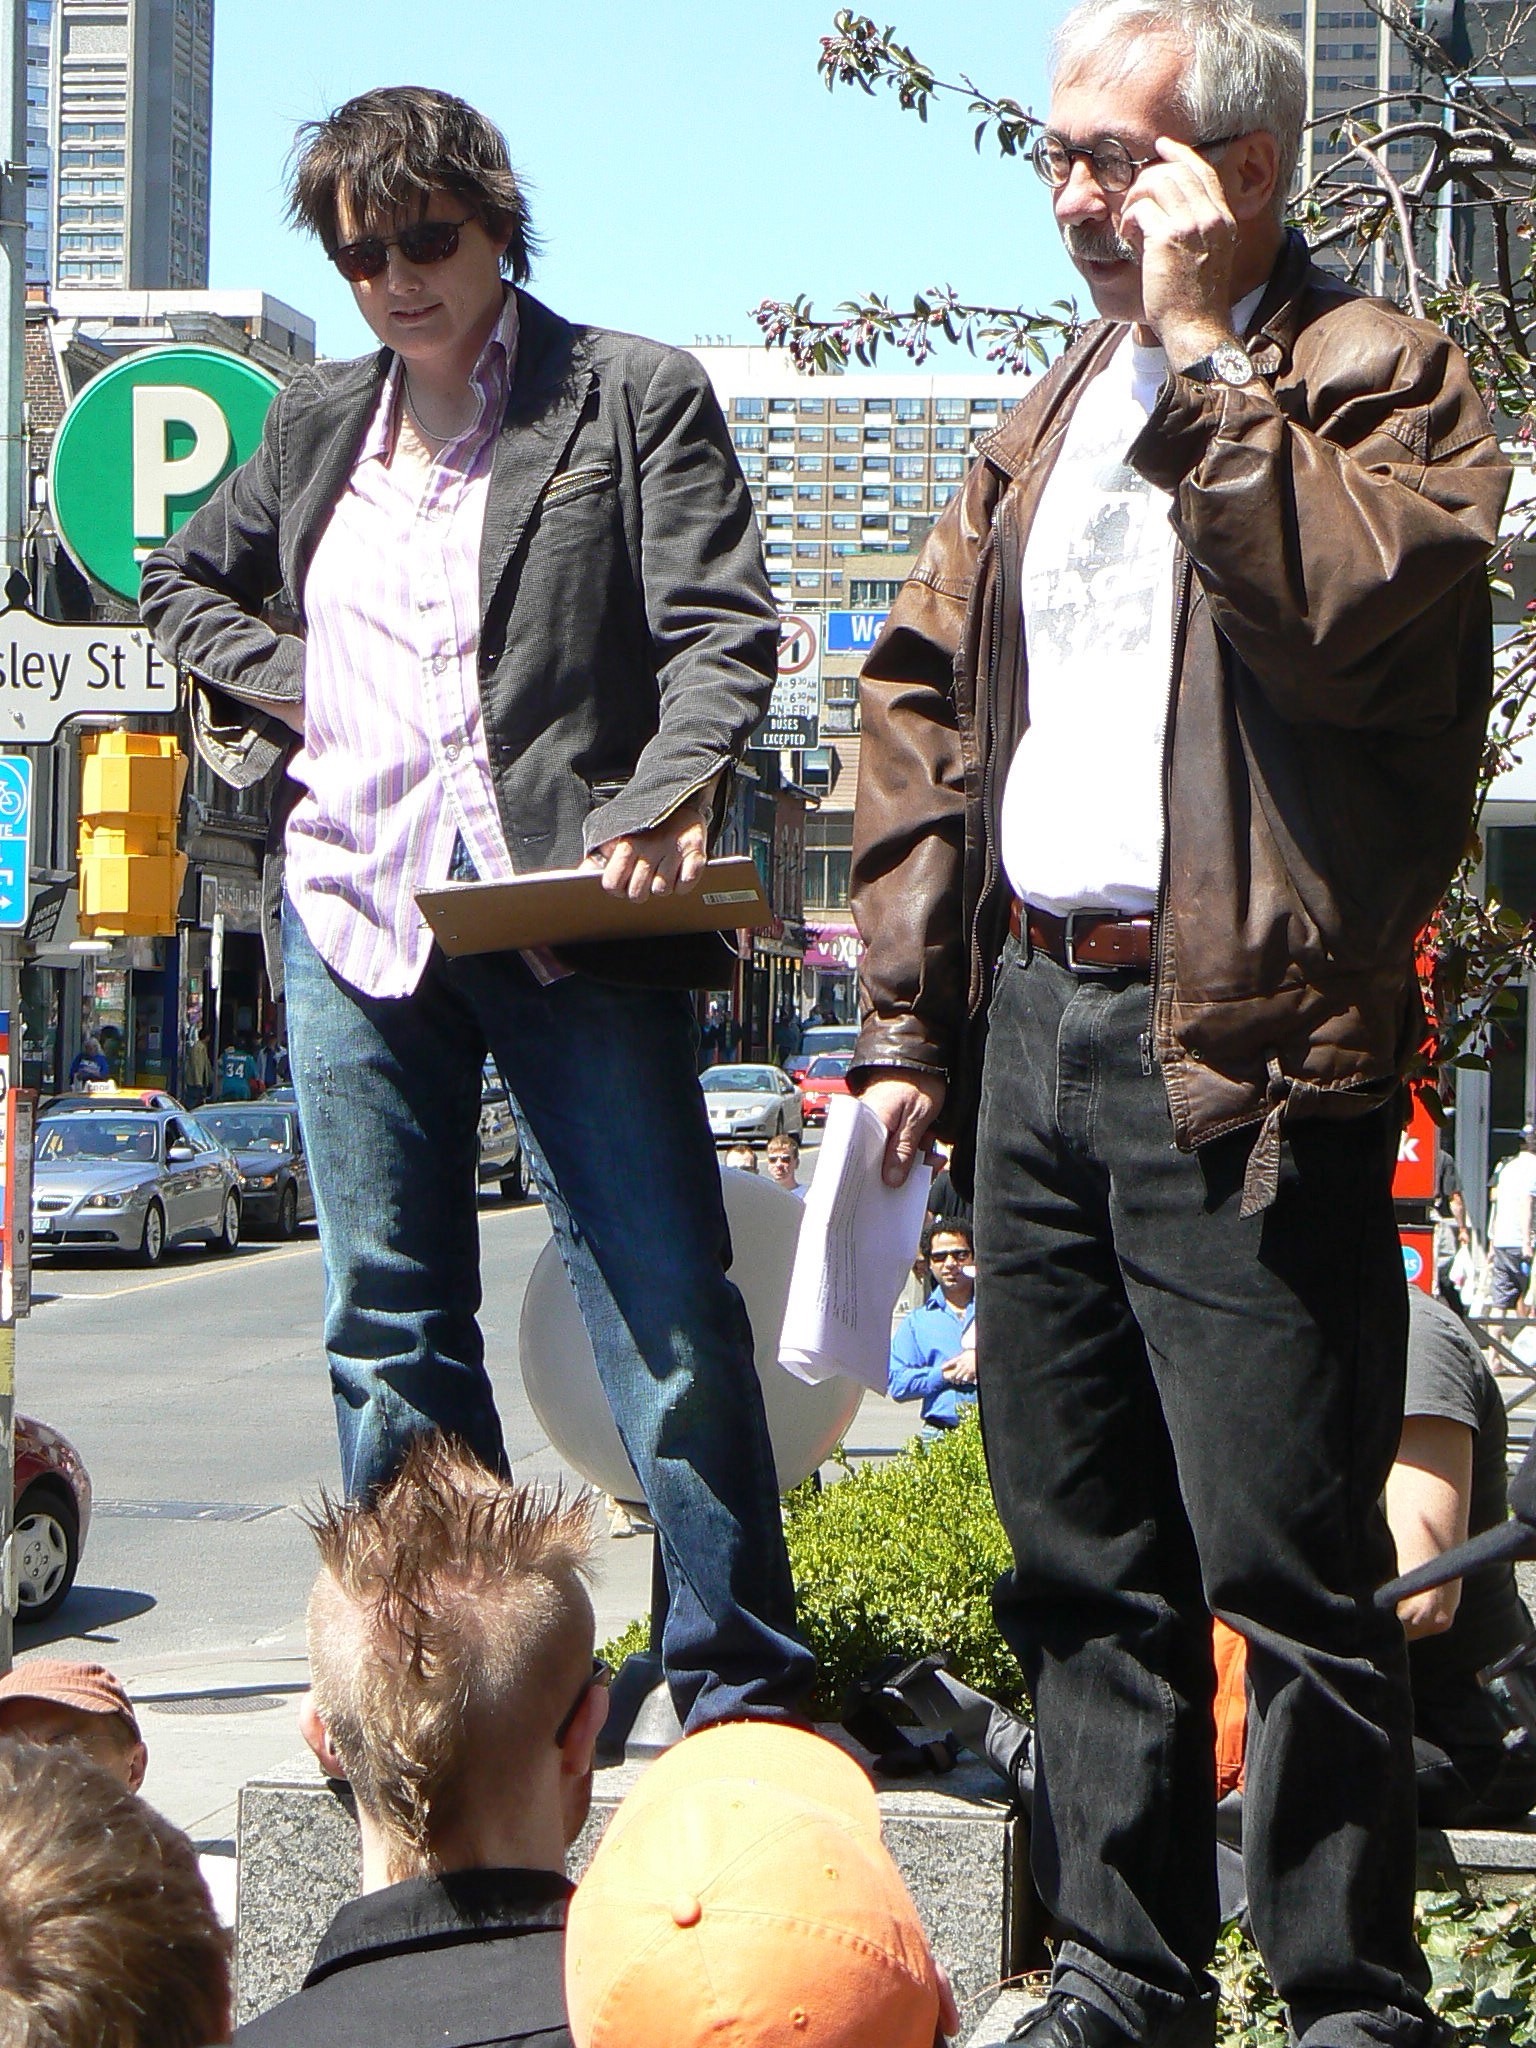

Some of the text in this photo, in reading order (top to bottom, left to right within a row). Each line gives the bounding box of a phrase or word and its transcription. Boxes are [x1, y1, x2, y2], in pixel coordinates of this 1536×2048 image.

[132, 385, 231, 540] P
[87, 642, 126, 689] St
[146, 642, 165, 689] E
[771, 719, 799, 730] BUSES
[763, 734, 806, 745] EXCEPTED
[226, 1063, 245, 1078] 34
